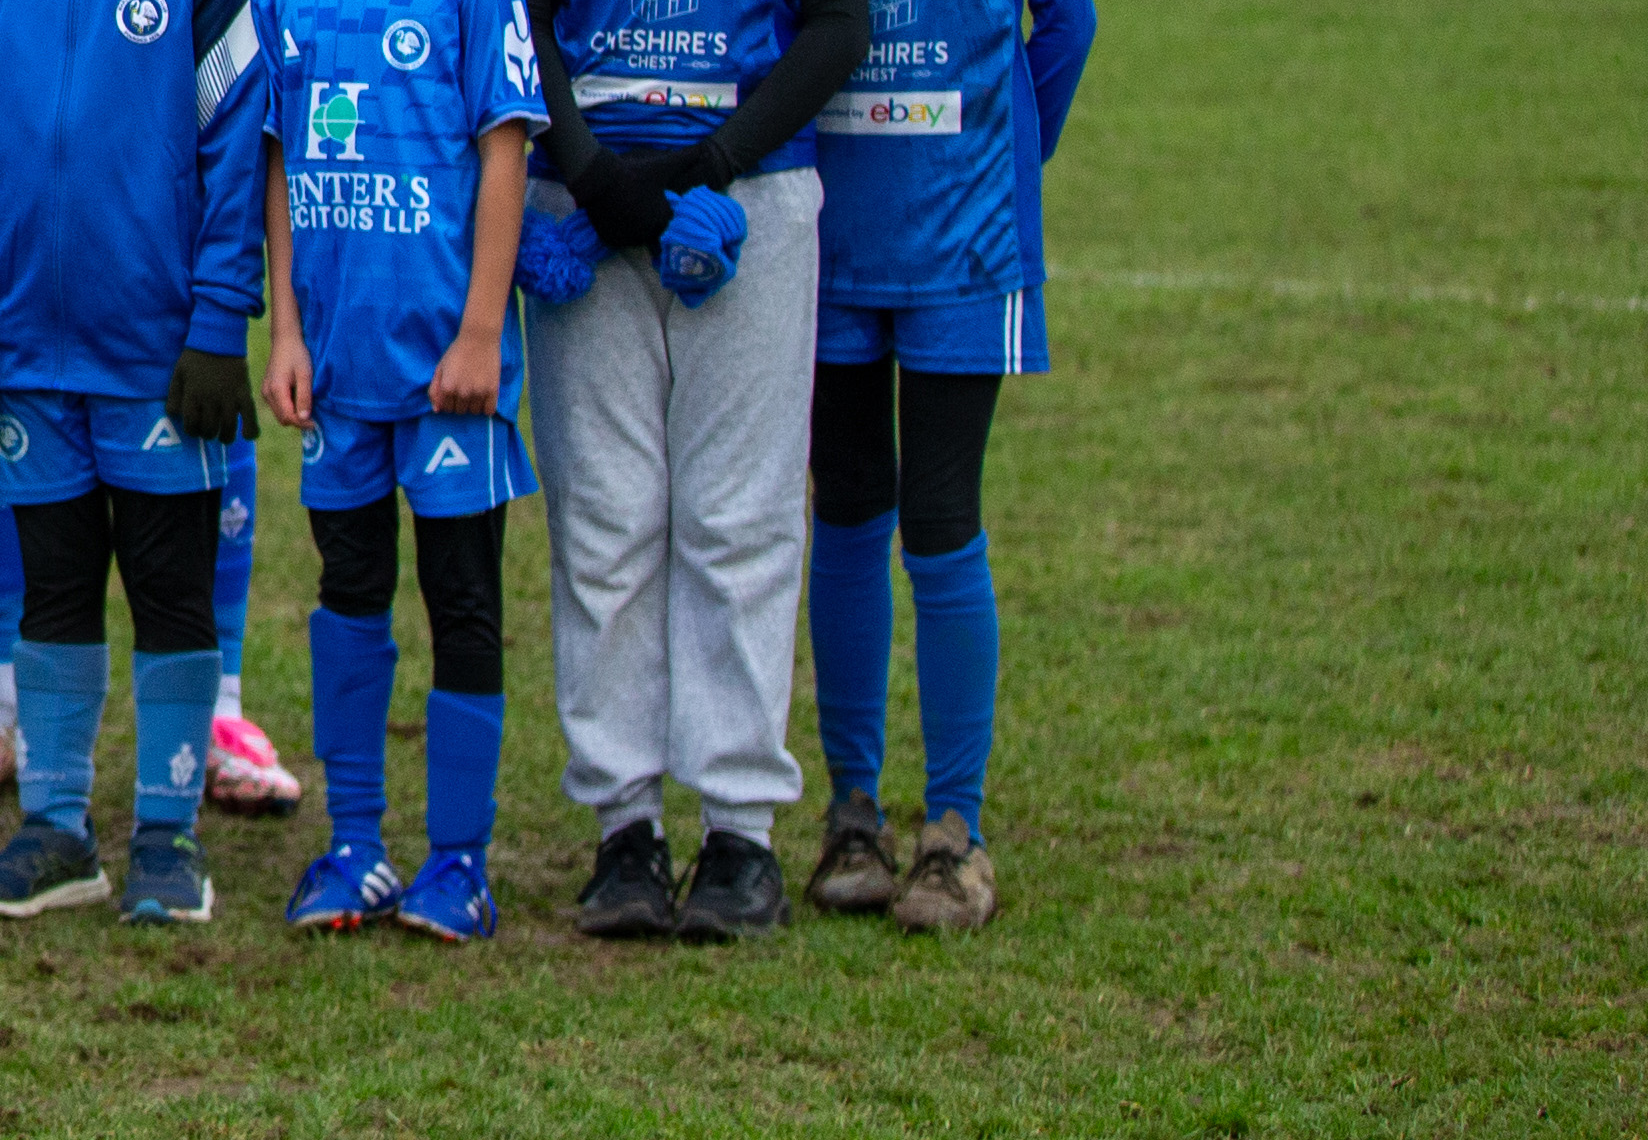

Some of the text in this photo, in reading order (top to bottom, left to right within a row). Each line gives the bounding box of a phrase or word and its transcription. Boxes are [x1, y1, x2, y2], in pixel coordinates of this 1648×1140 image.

[627, 53, 678, 71] CHEST
[868, 39, 949, 66] HIRE'S
[869, 96, 947, 128] ebay
[383, 208, 431, 235] LLP
